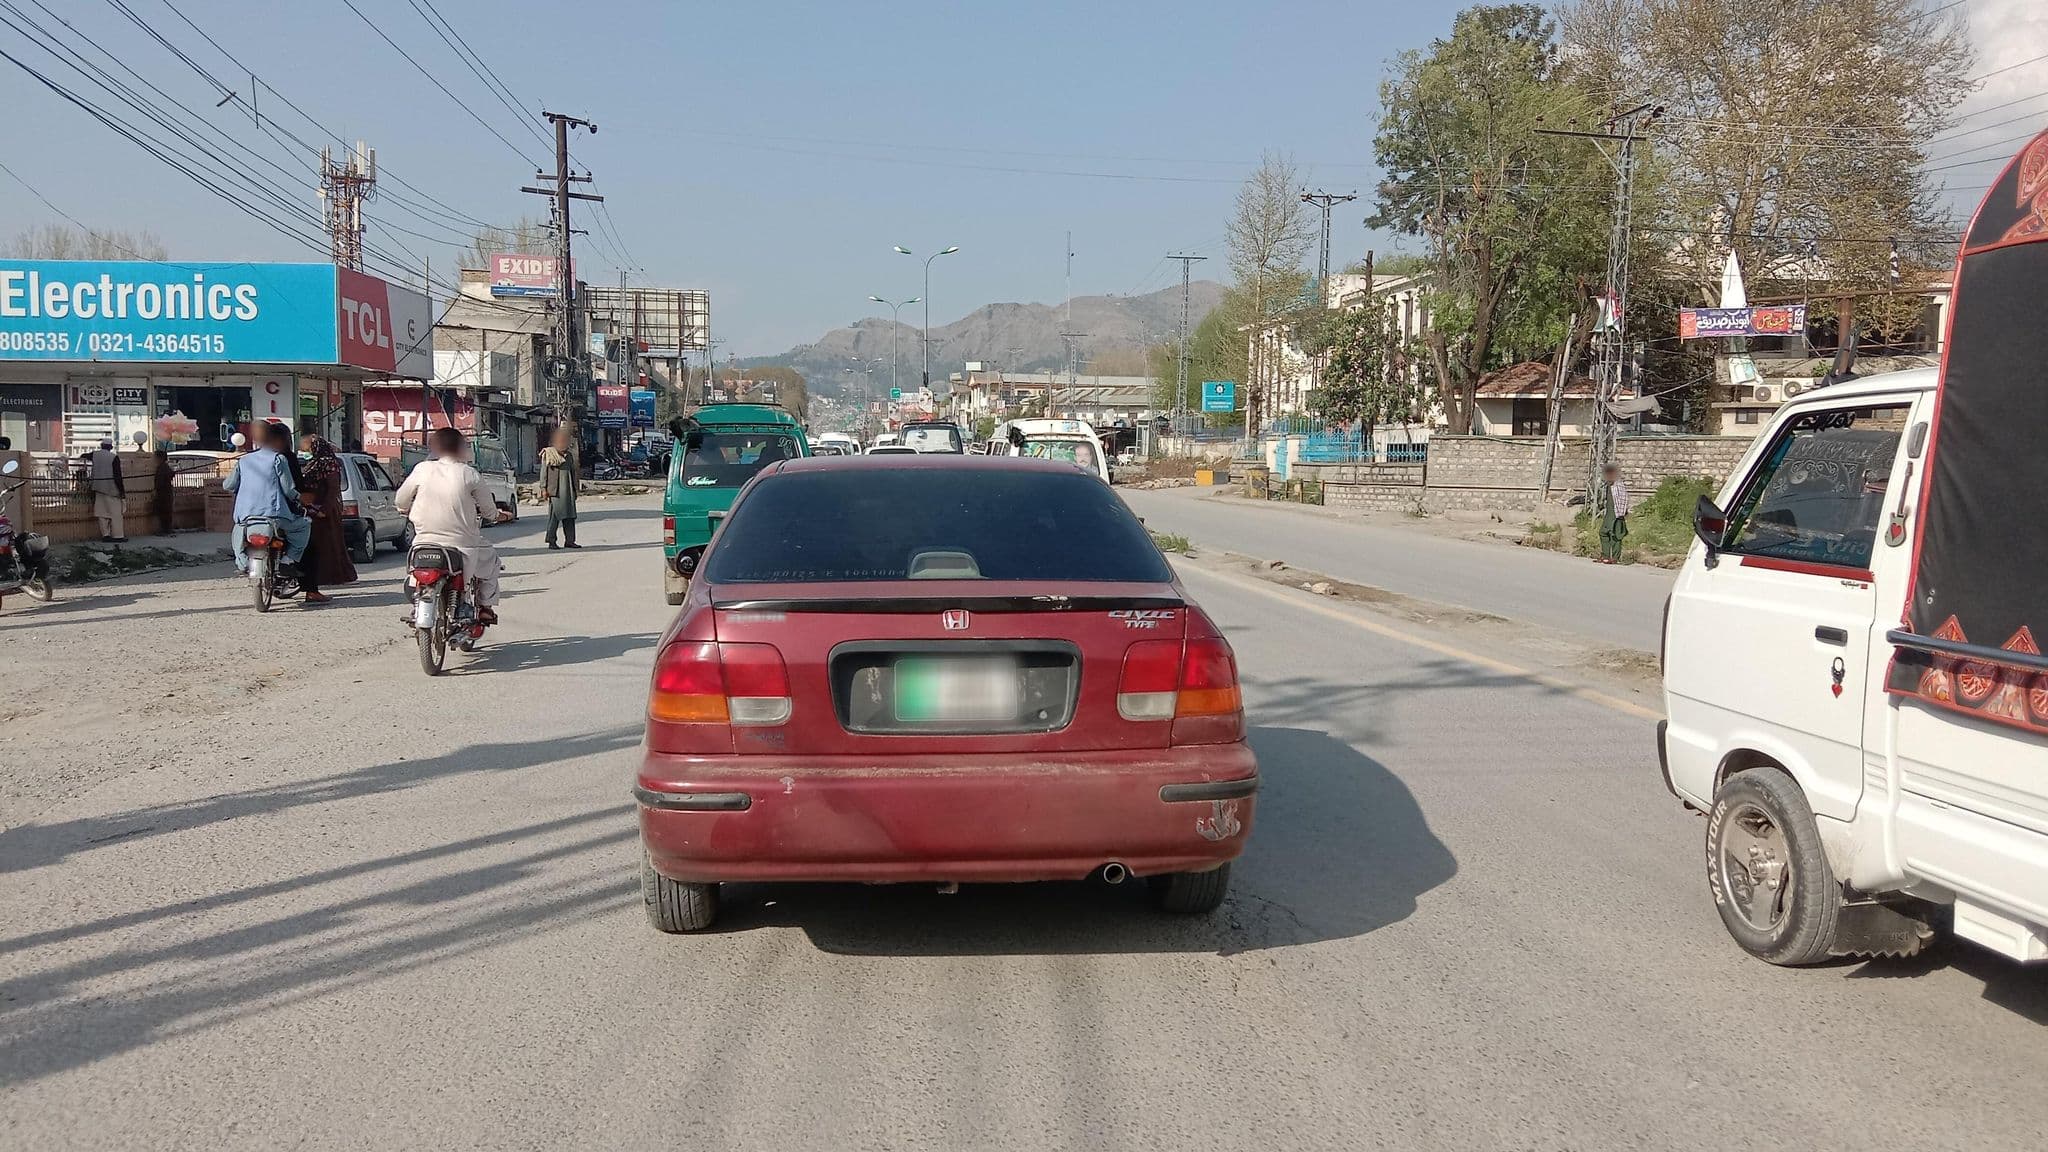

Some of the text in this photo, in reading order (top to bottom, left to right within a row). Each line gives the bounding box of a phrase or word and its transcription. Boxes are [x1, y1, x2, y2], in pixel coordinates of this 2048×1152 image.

[499, 258, 554, 275] EXIDE
[0, 270, 259, 321] Electronics
[342, 297, 389, 349] TCL
[0, 332, 70, 351] 808535
[89, 333, 225, 353] 0321-4364515
[115, 389, 142, 397] CITY
[1108, 609, 1175, 620] CIVIC
[1124, 620, 1156, 629] TYPE
[1706, 800, 1728, 905] MAXTOUR
